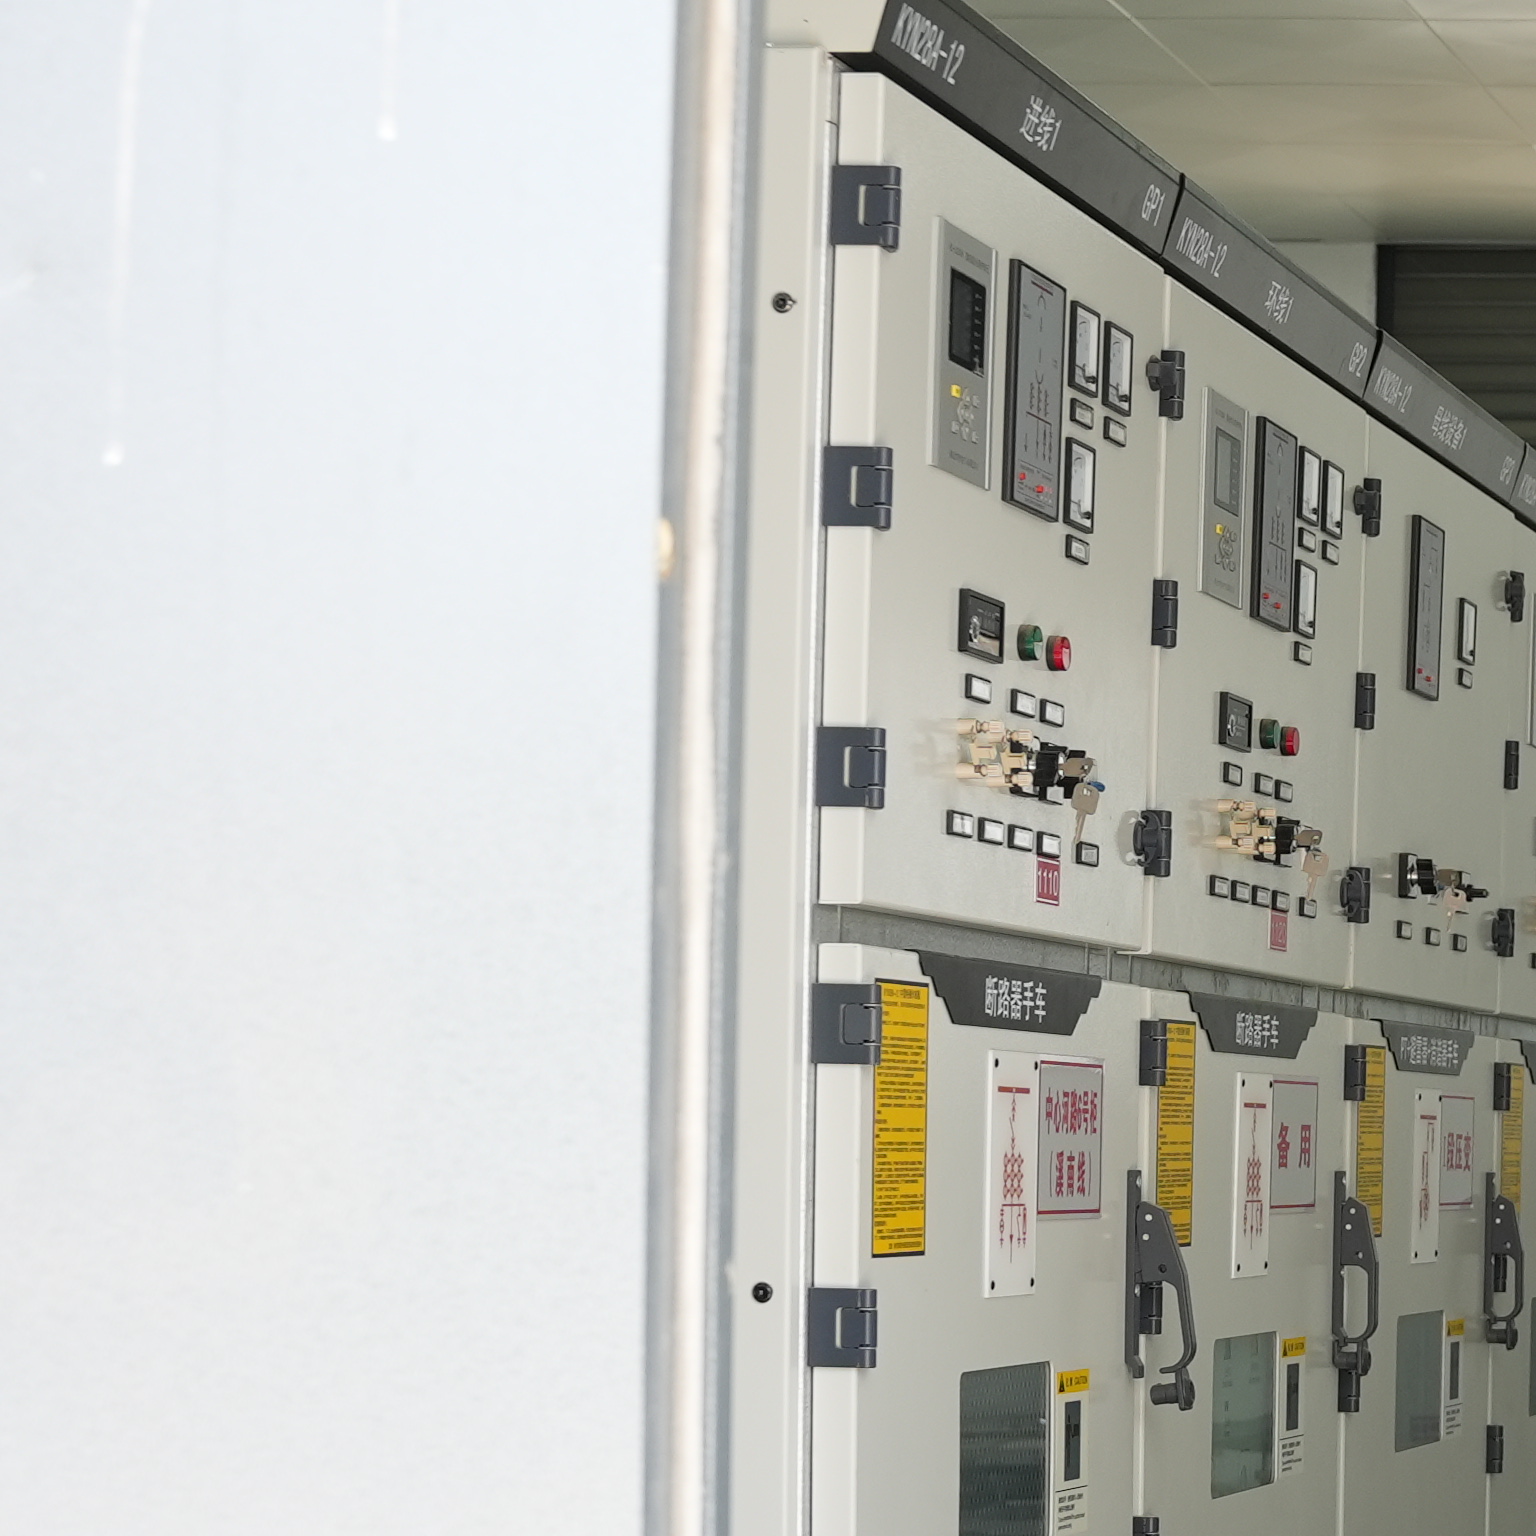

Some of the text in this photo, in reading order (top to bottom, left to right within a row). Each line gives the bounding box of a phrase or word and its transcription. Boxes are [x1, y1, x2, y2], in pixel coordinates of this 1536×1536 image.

[891, 4, 966, 86] KYN28A-12
[1019, 95, 1062, 151] 进线1
[1139, 183, 1166, 228] GP1
[1174, 216, 1229, 279] KYN28A-12
[1348, 341, 1368, 379] GP2
[1037, 864, 1060, 898] 1110
[1271, 915, 1287, 944] 1120
[984, 974, 1048, 1024] 断路器手车
[1234, 1010, 1280, 1051] 断路器手车
[1045, 1087, 1098, 1136] 中心河路6号柜
[1276, 1121, 1312, 1170] 备用
